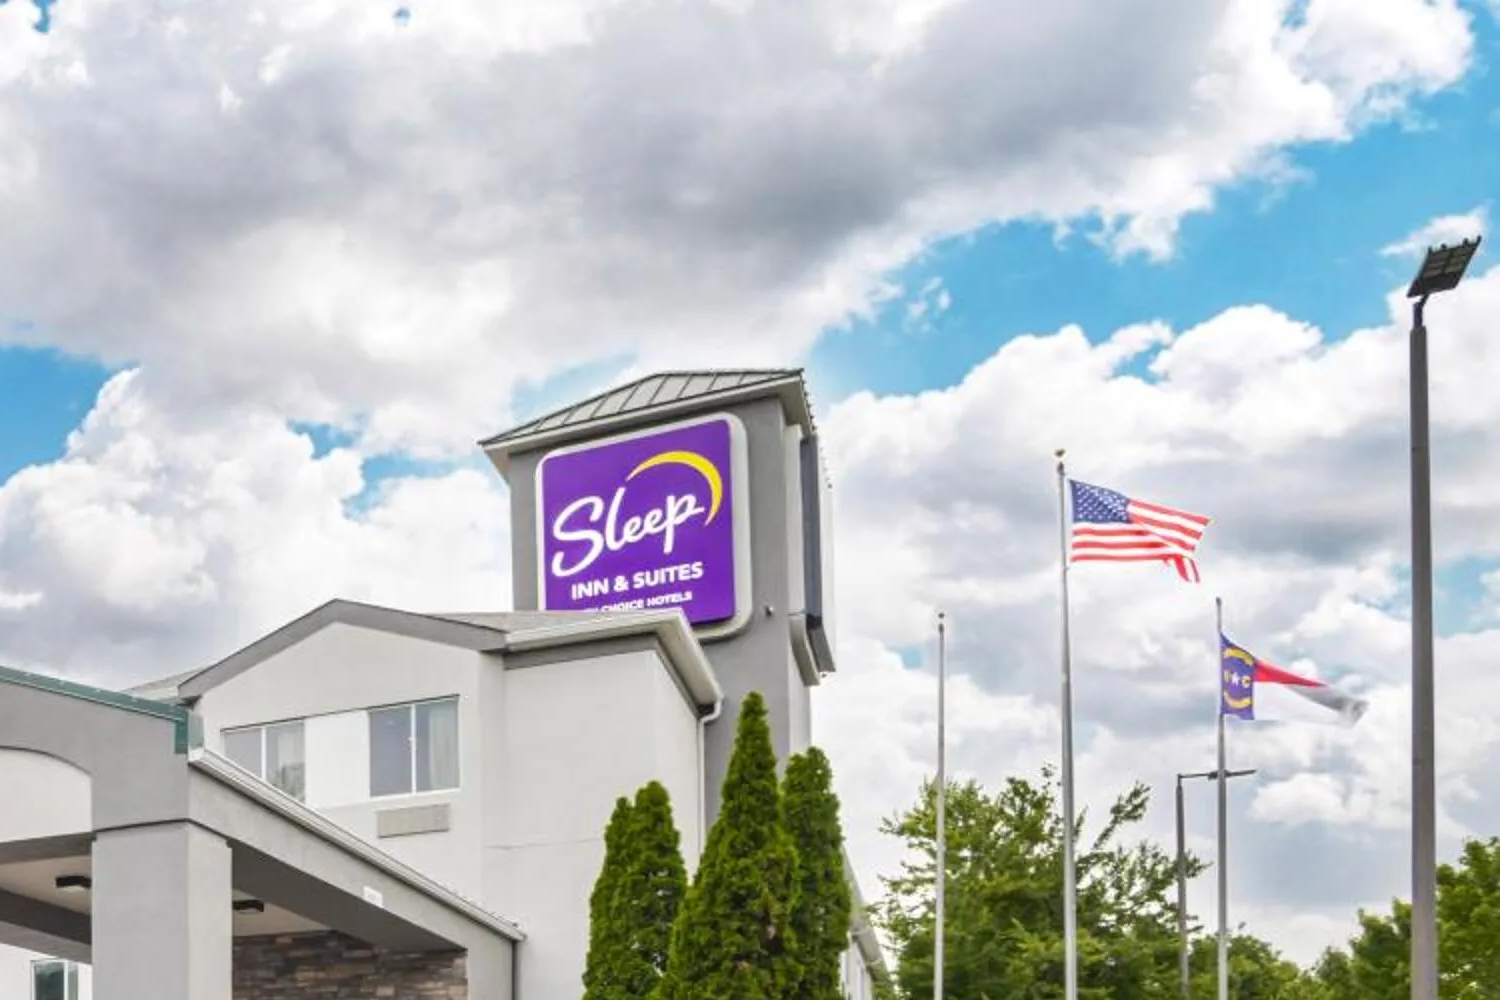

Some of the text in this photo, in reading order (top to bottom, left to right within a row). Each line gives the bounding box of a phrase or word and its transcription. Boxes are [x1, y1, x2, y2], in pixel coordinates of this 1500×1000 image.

[551, 487, 705, 577] Sleep
[571, 561, 703, 600] INN & SUITES
[647, 591, 692, 607] HOTELS
